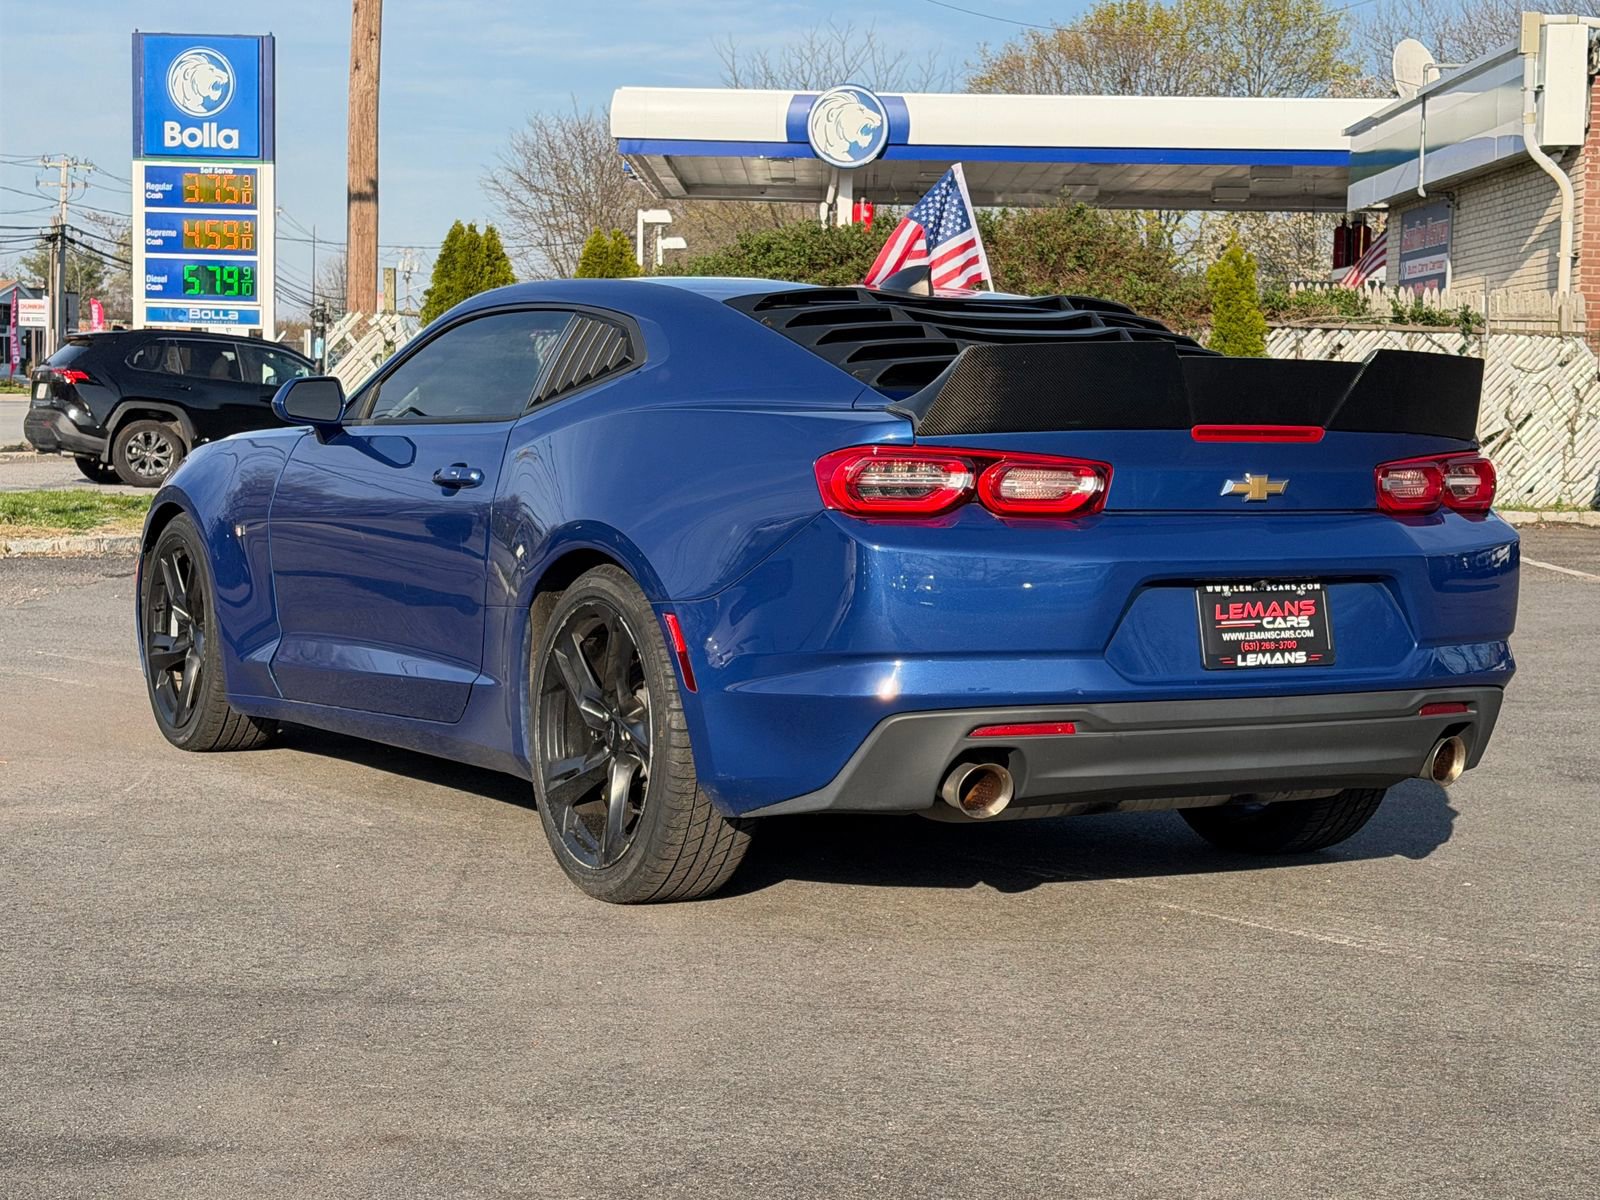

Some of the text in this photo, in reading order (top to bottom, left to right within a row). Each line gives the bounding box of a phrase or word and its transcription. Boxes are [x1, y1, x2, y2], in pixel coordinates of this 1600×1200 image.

[163, 121, 239, 149] Bolla
[145, 182, 173, 191] Regular
[183, 173, 239, 204] 3.75
[145, 228, 177, 238] Supreme
[183, 220, 239, 250] 4.59
[145, 238, 163, 246] Cash
[145, 275, 168, 283] Diesel
[243, 266, 251, 280] 9
[183, 265, 239, 296] 5.79
[1206, 583, 1321, 593] WWW.LEMSCARS.COM
[1215, 600, 1316, 620] LEMANS
[1262, 616, 1311, 628] CARS
[1222, 629, 1315, 641] WWW.LEMANSCARS.COM
[1240, 640, 1297, 652] (631) 268-3700
[1237, 651, 1307, 666] LEMANS
